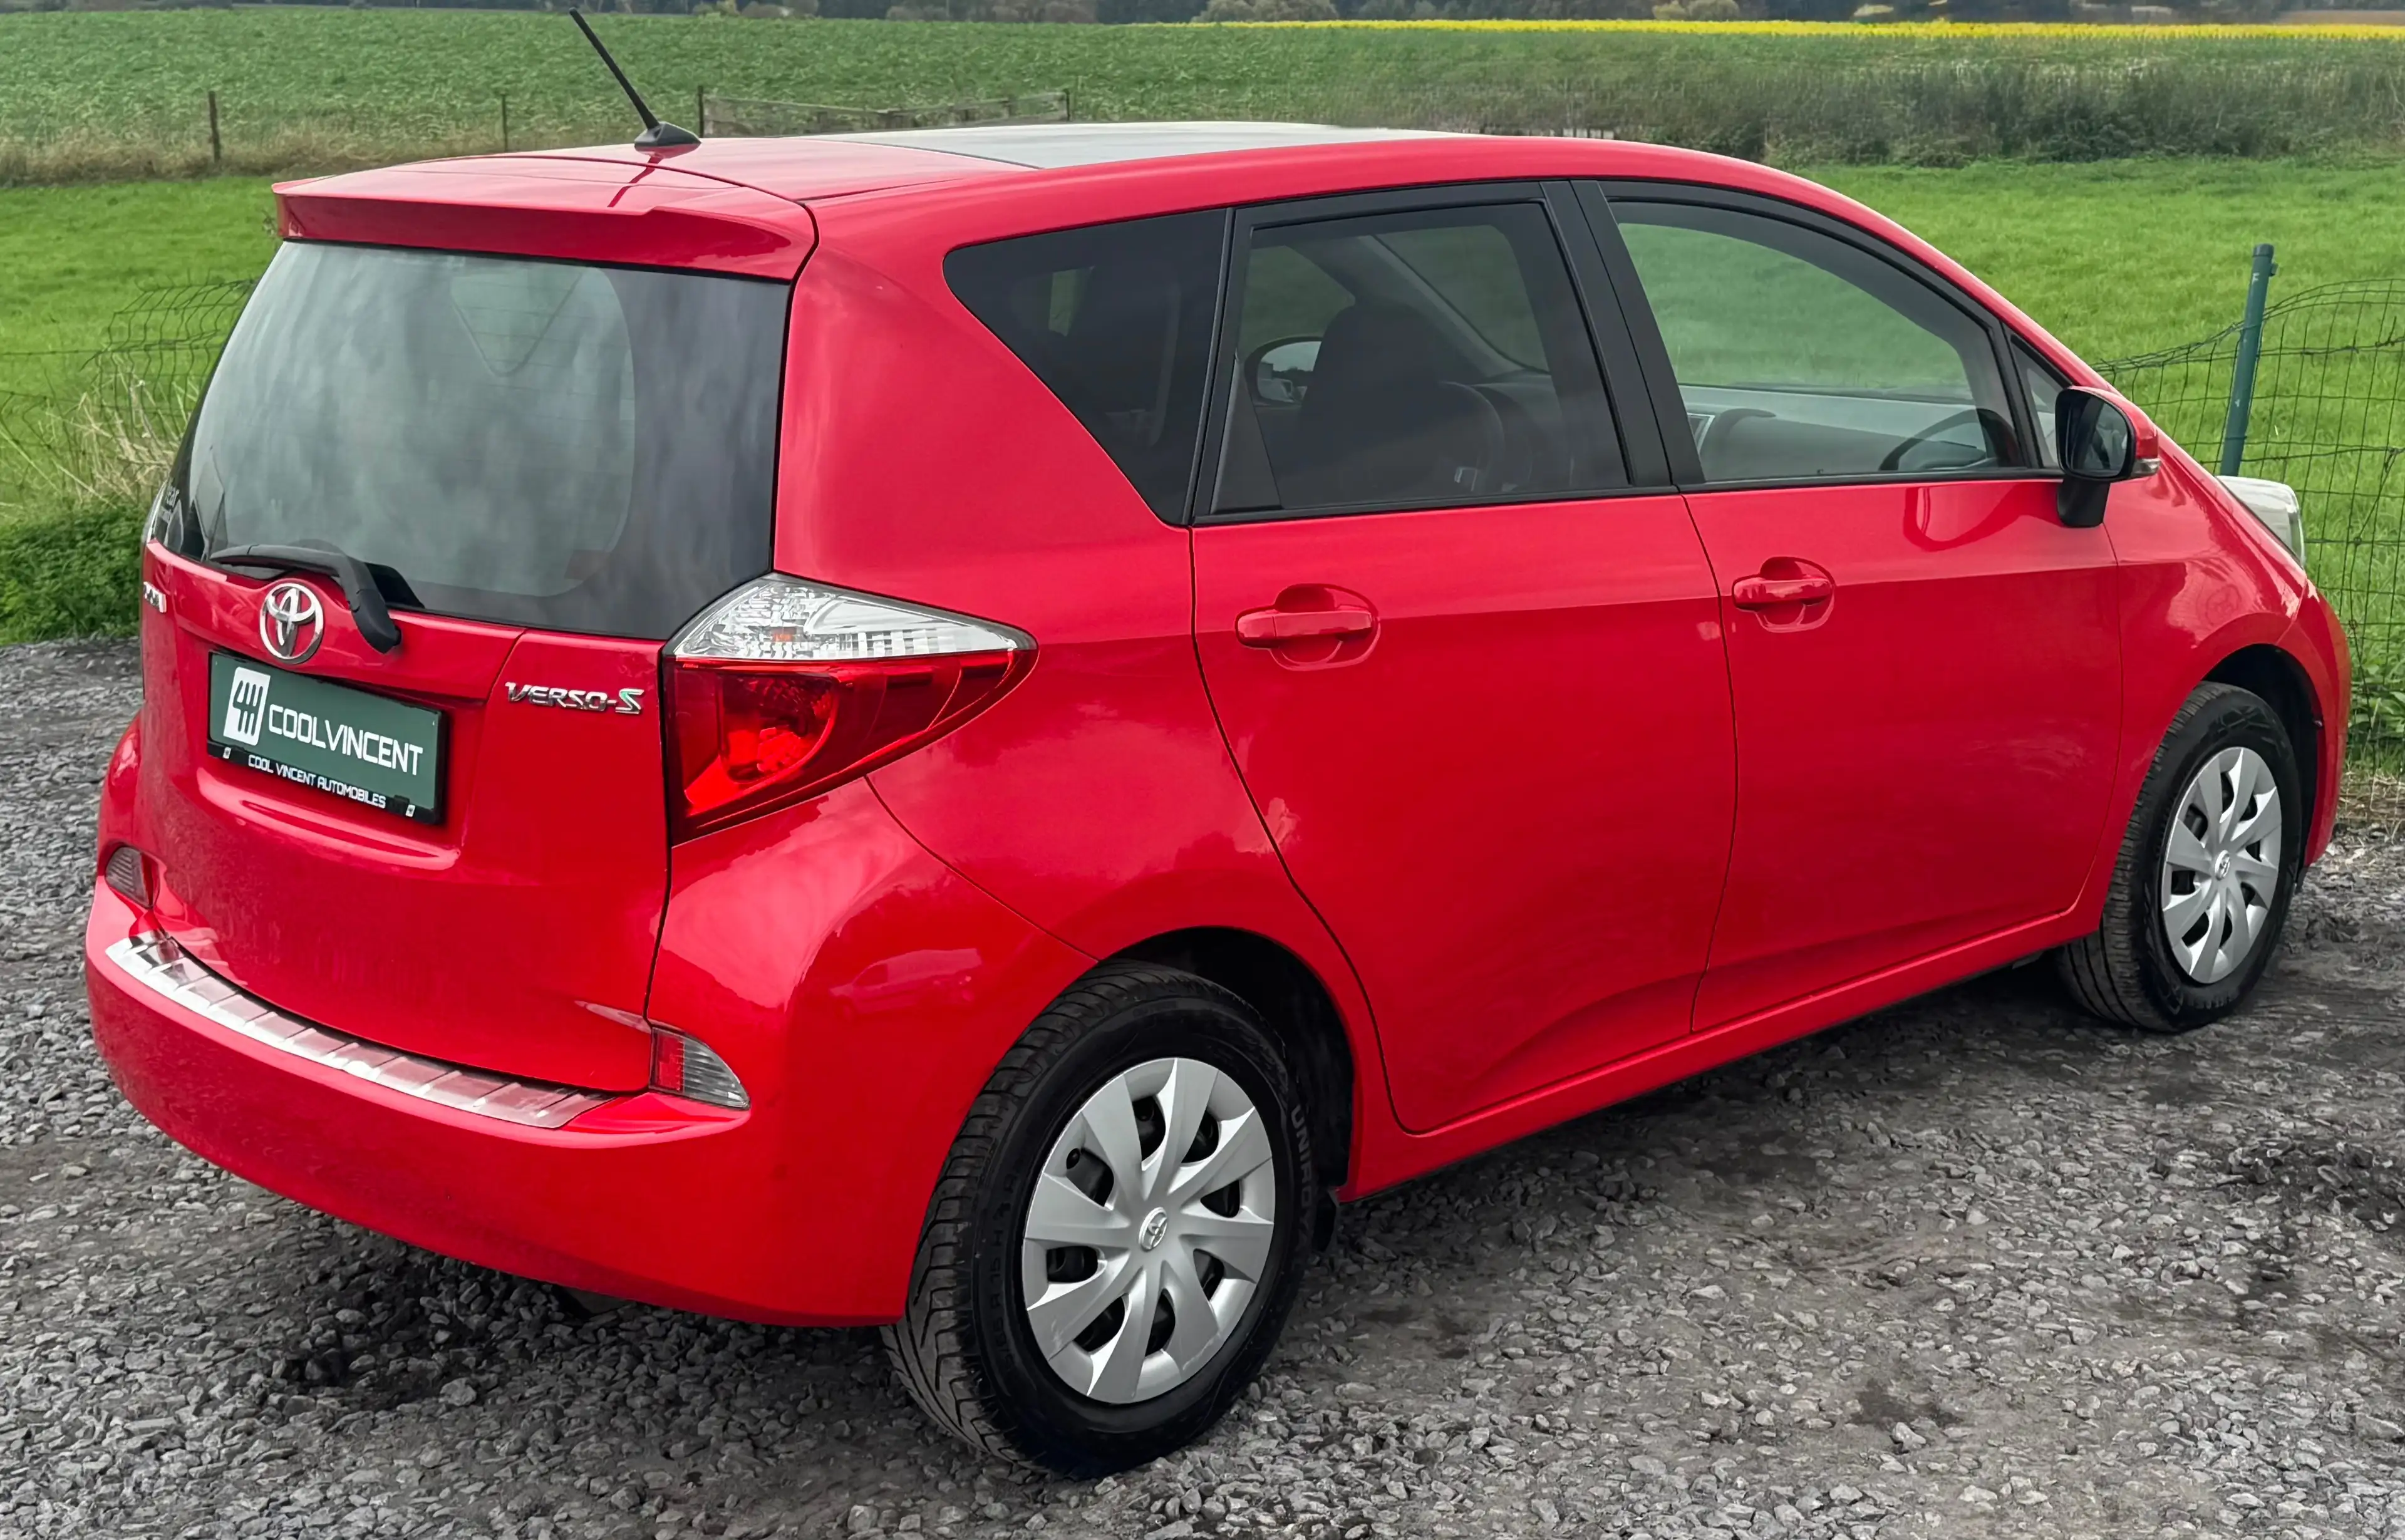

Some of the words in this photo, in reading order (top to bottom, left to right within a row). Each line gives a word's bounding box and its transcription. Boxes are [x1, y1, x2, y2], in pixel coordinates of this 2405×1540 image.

[505, 681, 644, 715] VERSO-S
[248, 754, 274, 774] COOL
[276, 762, 317, 787] VINCENT
[317, 775, 386, 809] AUTOMOBILES
